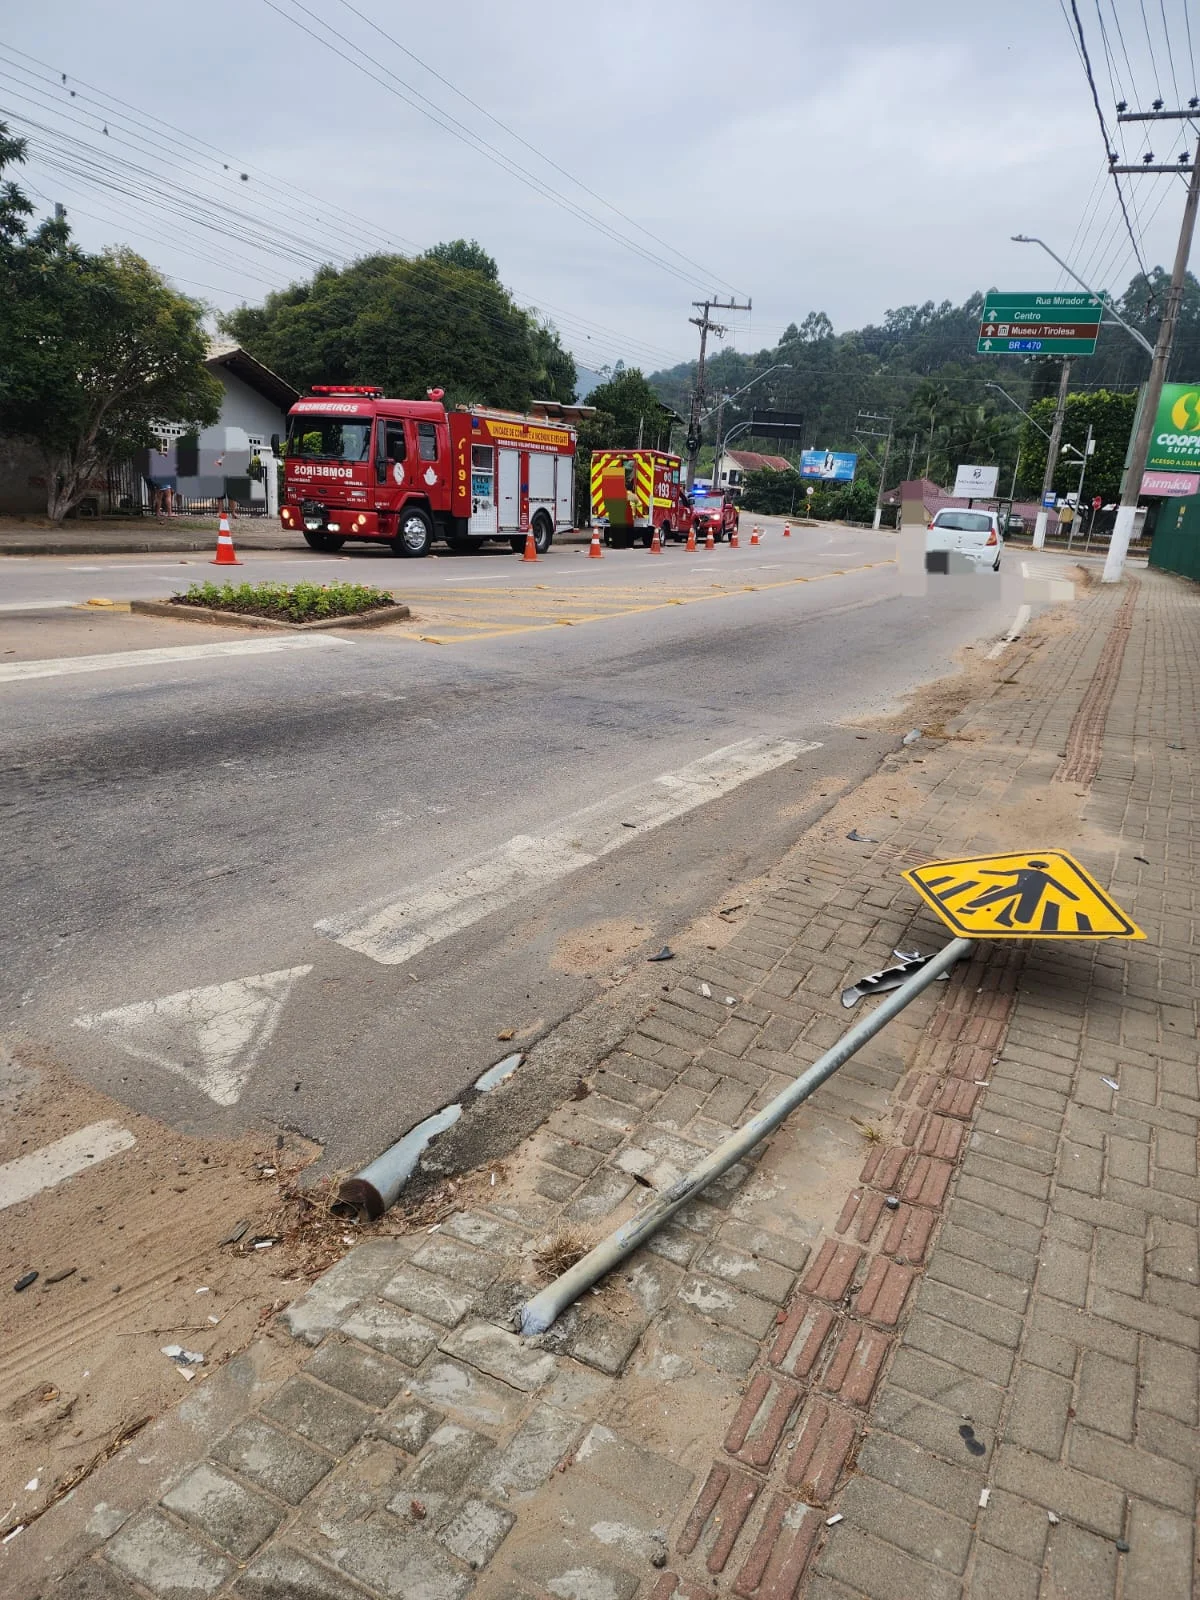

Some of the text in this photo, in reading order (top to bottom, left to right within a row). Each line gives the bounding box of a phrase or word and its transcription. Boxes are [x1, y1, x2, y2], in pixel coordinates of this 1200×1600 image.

[1035, 296, 1085, 305] Rua Mirador
[1014, 311, 1041, 320] Centro
[1011, 326, 1037, 335] Museu
[1043, 326, 1075, 336] Tirolesa
[1008, 341, 1020, 350] BR
[1026, 341, 1042, 350] 470
[297, 403, 359, 413] BOMBEIROS
[458, 454, 466, 497] 193
[1143, 477, 1192, 490] Farmácia
[658, 482, 669, 498] 193
